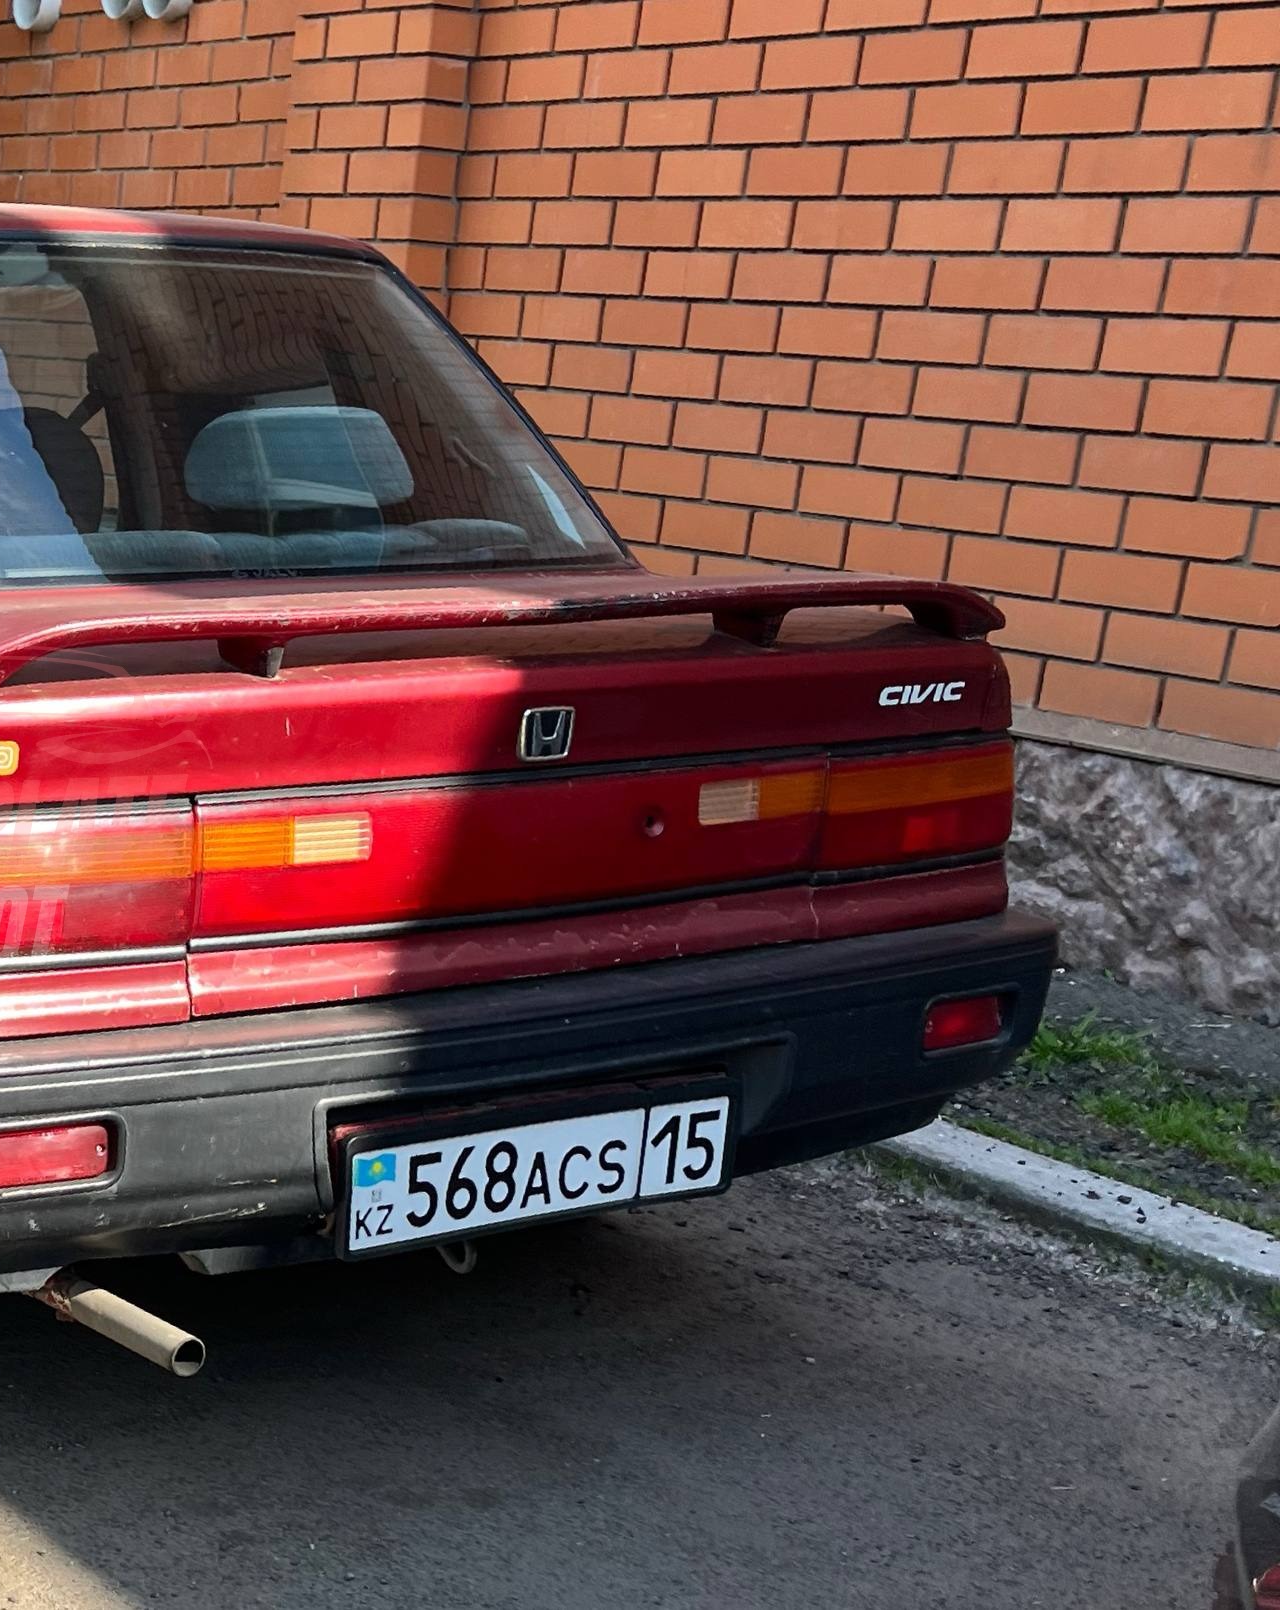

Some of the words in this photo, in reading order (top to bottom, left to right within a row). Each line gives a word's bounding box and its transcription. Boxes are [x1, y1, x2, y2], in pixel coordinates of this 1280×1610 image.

[878, 681, 966, 706] CIVIC
[406, 1139, 628, 1228] 568ACS
[651, 1109, 722, 1184] 15
[355, 1203, 394, 1240] KZ
